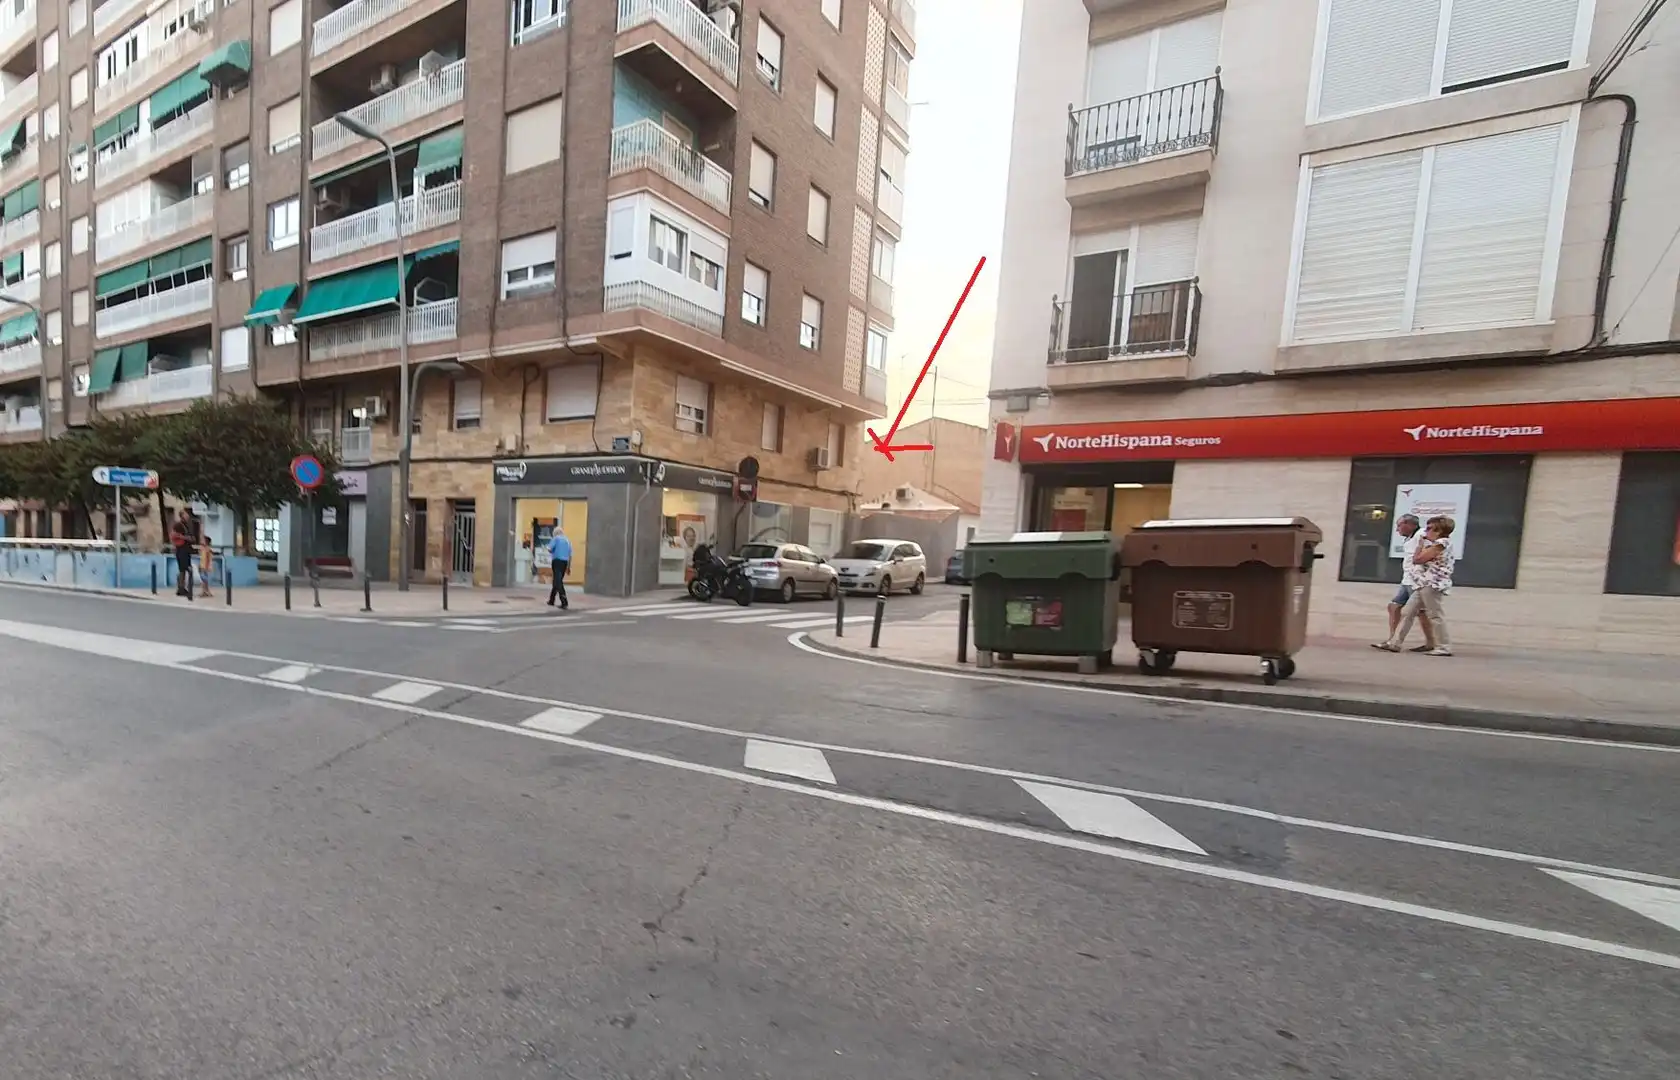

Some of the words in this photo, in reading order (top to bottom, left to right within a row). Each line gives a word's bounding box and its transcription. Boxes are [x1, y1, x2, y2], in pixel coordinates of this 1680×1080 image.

[1426, 425, 1543, 438] NorteHispana
[1055, 433, 1172, 450] NorteHispana
[1174, 437, 1222, 448] Seguros
